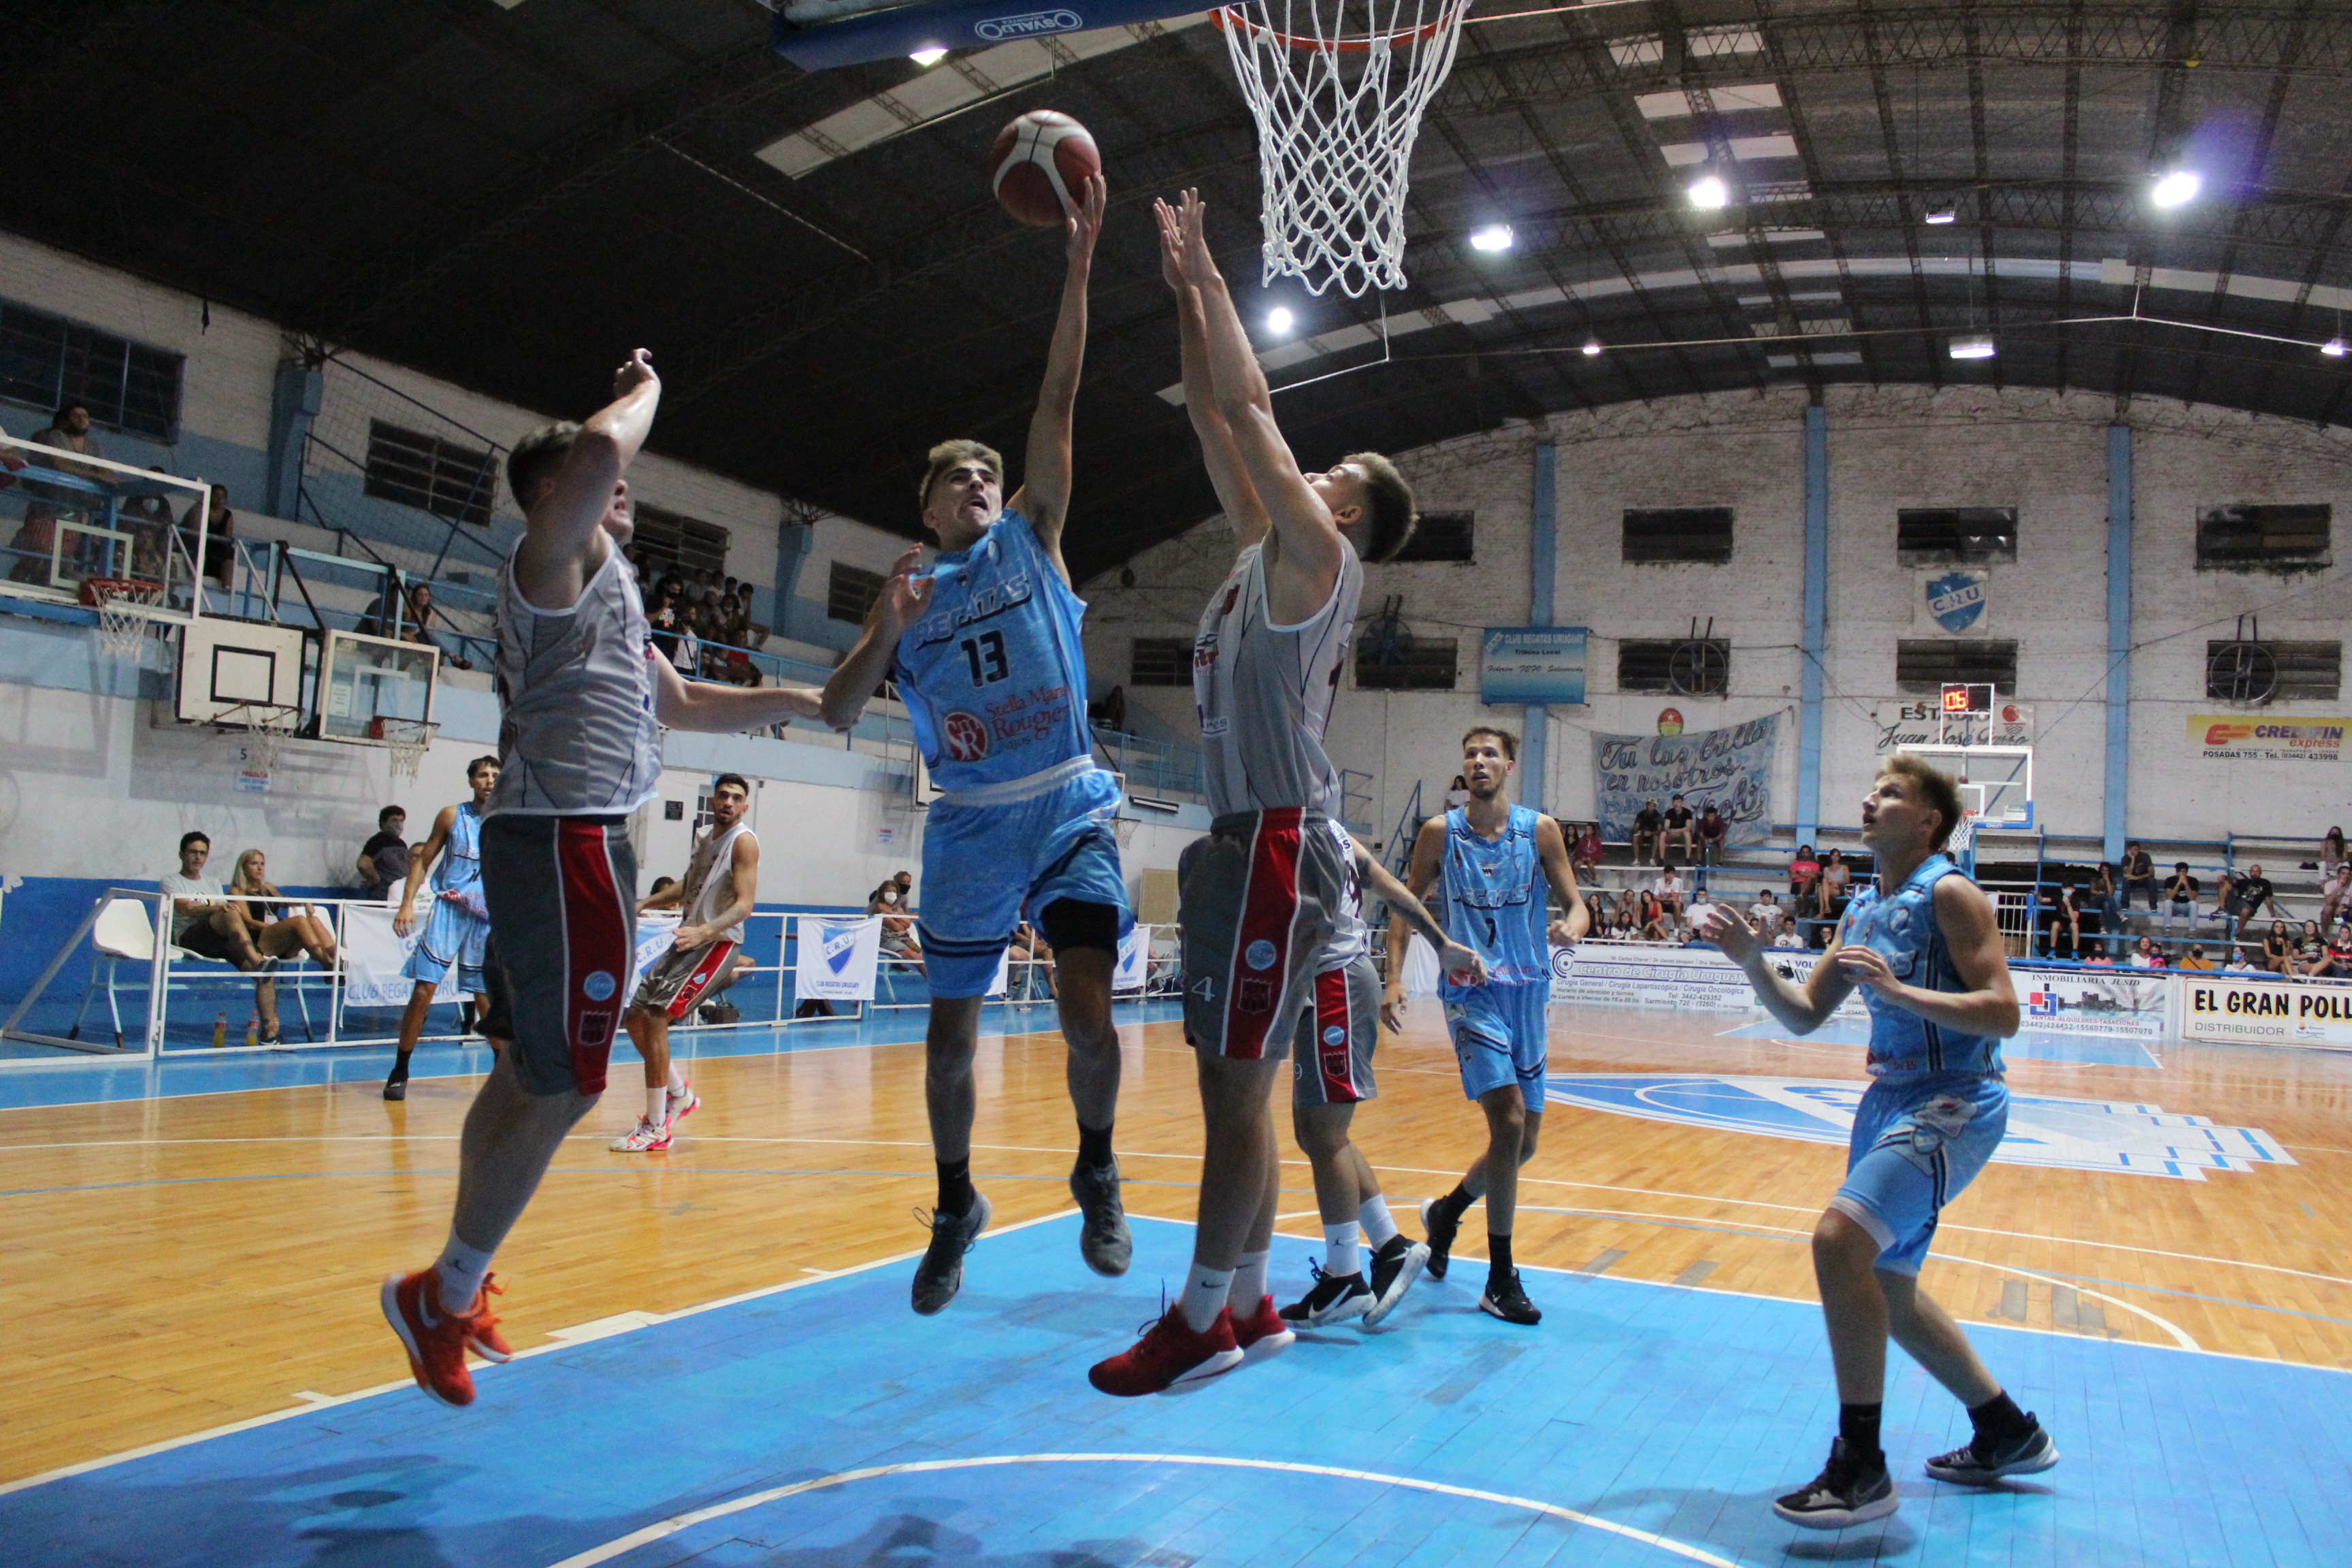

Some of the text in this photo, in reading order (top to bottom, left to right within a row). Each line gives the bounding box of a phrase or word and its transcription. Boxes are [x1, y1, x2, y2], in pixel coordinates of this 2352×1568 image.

[979, 12, 1078, 39] OSVALDO
[1505, 634, 1584, 644] CLUB REGATAS URUGUAY
[960, 630, 1009, 687] 13
[1945, 691, 1967, 710] 06
[1878, 722, 1929, 749] Juan
[2255, 725, 2344, 740] CREDFIN
[2289, 739, 2340, 749] express
[240, 748, 247, 760] 5
[1607, 774, 1631, 792] en
[1485, 917, 1497, 948] 7
[1579, 964, 1621, 976] Centro
[1623, 964, 1640, 977] de
[1690, 969, 1746, 984] Uruguay
[2031, 974, 2140, 987] INMOBILIARIA JUSID
[348, 983, 378, 1000] CLUB
[382, 983, 414, 999] REGAT
[1192, 976, 1215, 1002] 4
[2193, 989, 2219, 1013] EL
[2225, 990, 2290, 1017] GRAN
[2195, 1022, 2285, 1036] DISTRIBUIDOR
